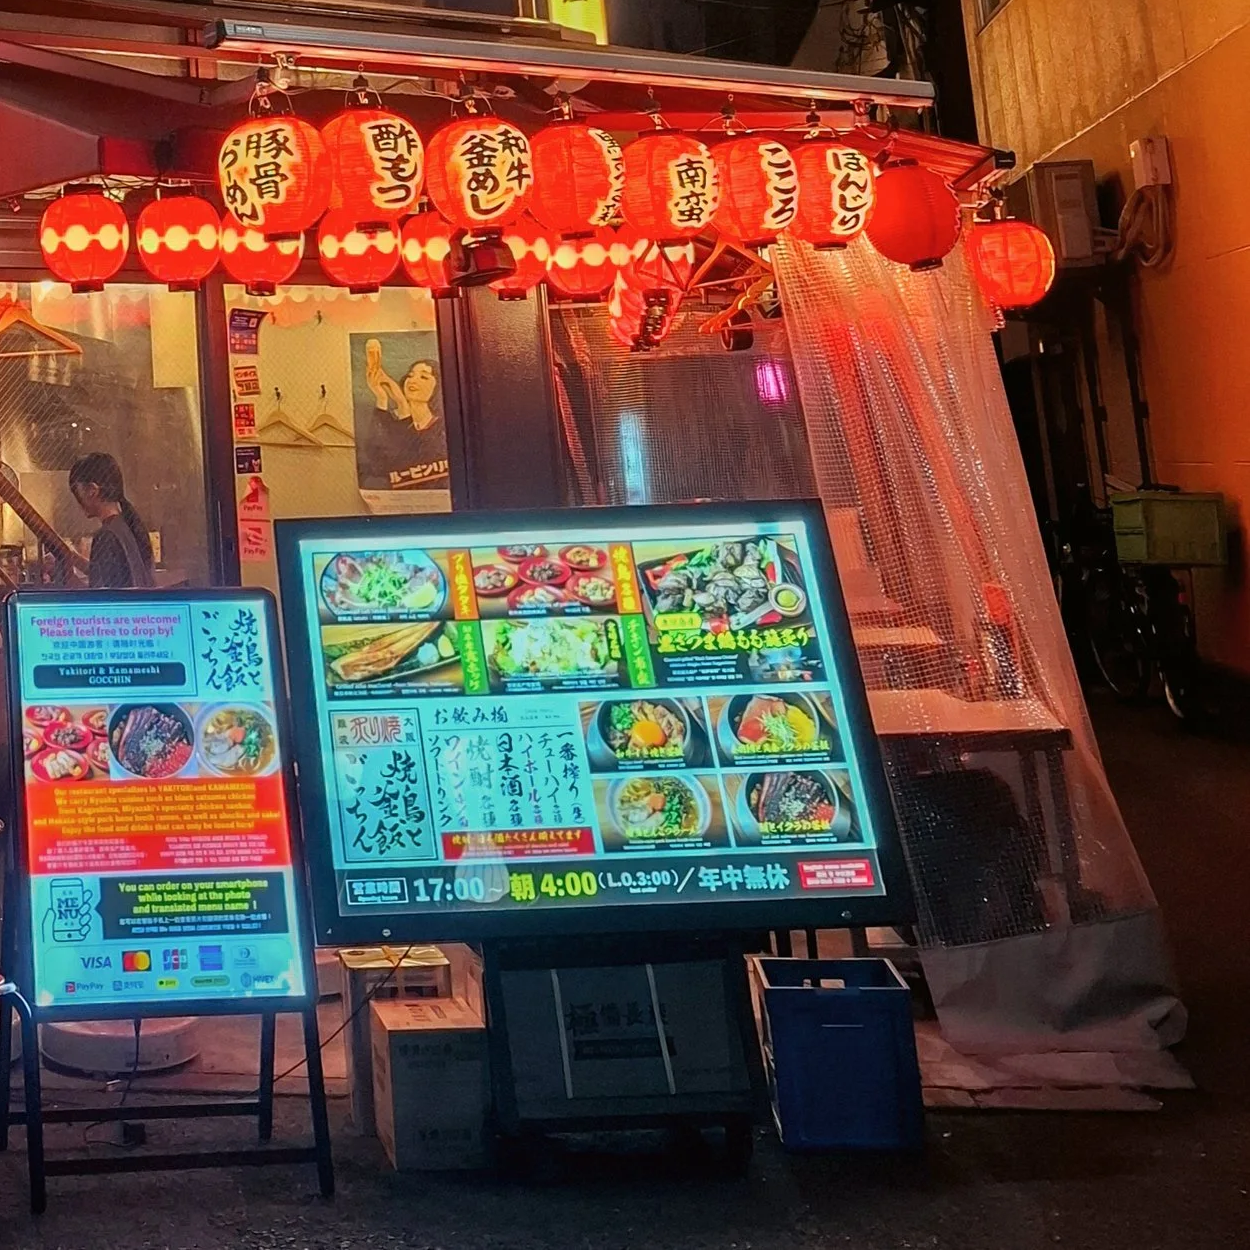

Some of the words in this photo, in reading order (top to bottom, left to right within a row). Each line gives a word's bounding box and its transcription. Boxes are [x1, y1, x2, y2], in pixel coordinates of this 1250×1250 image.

[245, 128, 294, 199] 豚骨
[367, 123, 418, 203] 酢もつ
[496, 128, 532, 191] 和牛
[221, 139, 260, 222] らーめん
[460, 133, 506, 215] 釜めし
[765, 147, 797, 224] こころ
[674, 158, 707, 223] 南蛮
[31, 616, 69, 628] Foreign
[71, 615, 111, 625] tourists
[132, 614, 181, 624] welcome!
[40, 627, 73, 637] Please
[76, 627, 94, 636] feel
[97, 627, 116, 636] free
[119, 627, 129, 636] to
[132, 626, 156, 638] drop
[158, 626, 174, 637] by!
[201, 610, 222, 690] ごっちん
[229, 609, 263, 685] 焼鳥と
[59, 667, 96, 676] Yakitori
[109, 666, 160, 674] Kamameshi
[89, 676, 132, 684] GOCCHIN
[435, 706, 508, 725] お飲み物
[345, 753, 373, 853] ごっちん
[380, 750, 425, 847] 焼鳥と
[119, 883, 136, 892] You
[138, 883, 155, 891] can
[156, 881, 180, 891] order
[194, 882, 214, 891] your
[215, 879, 268, 890] smartphone
[413, 877, 484, 901] 17:00
[540, 871, 598, 897] 4:00
[698, 863, 790, 892] 年中無休
[57, 897, 78, 908] ME
[132, 905, 150, 914] and
[151, 903, 196, 913] translated
[198, 903, 223, 911] menu
[224, 903, 249, 911] name
[138, 893, 162, 902] while
[163, 892, 197, 903] looking
[209, 891, 223, 900] the
[225, 891, 251, 901] photo
[58, 909, 79, 920] NU
[80, 957, 112, 969] VISA
[76, 982, 104, 992] PayPay
